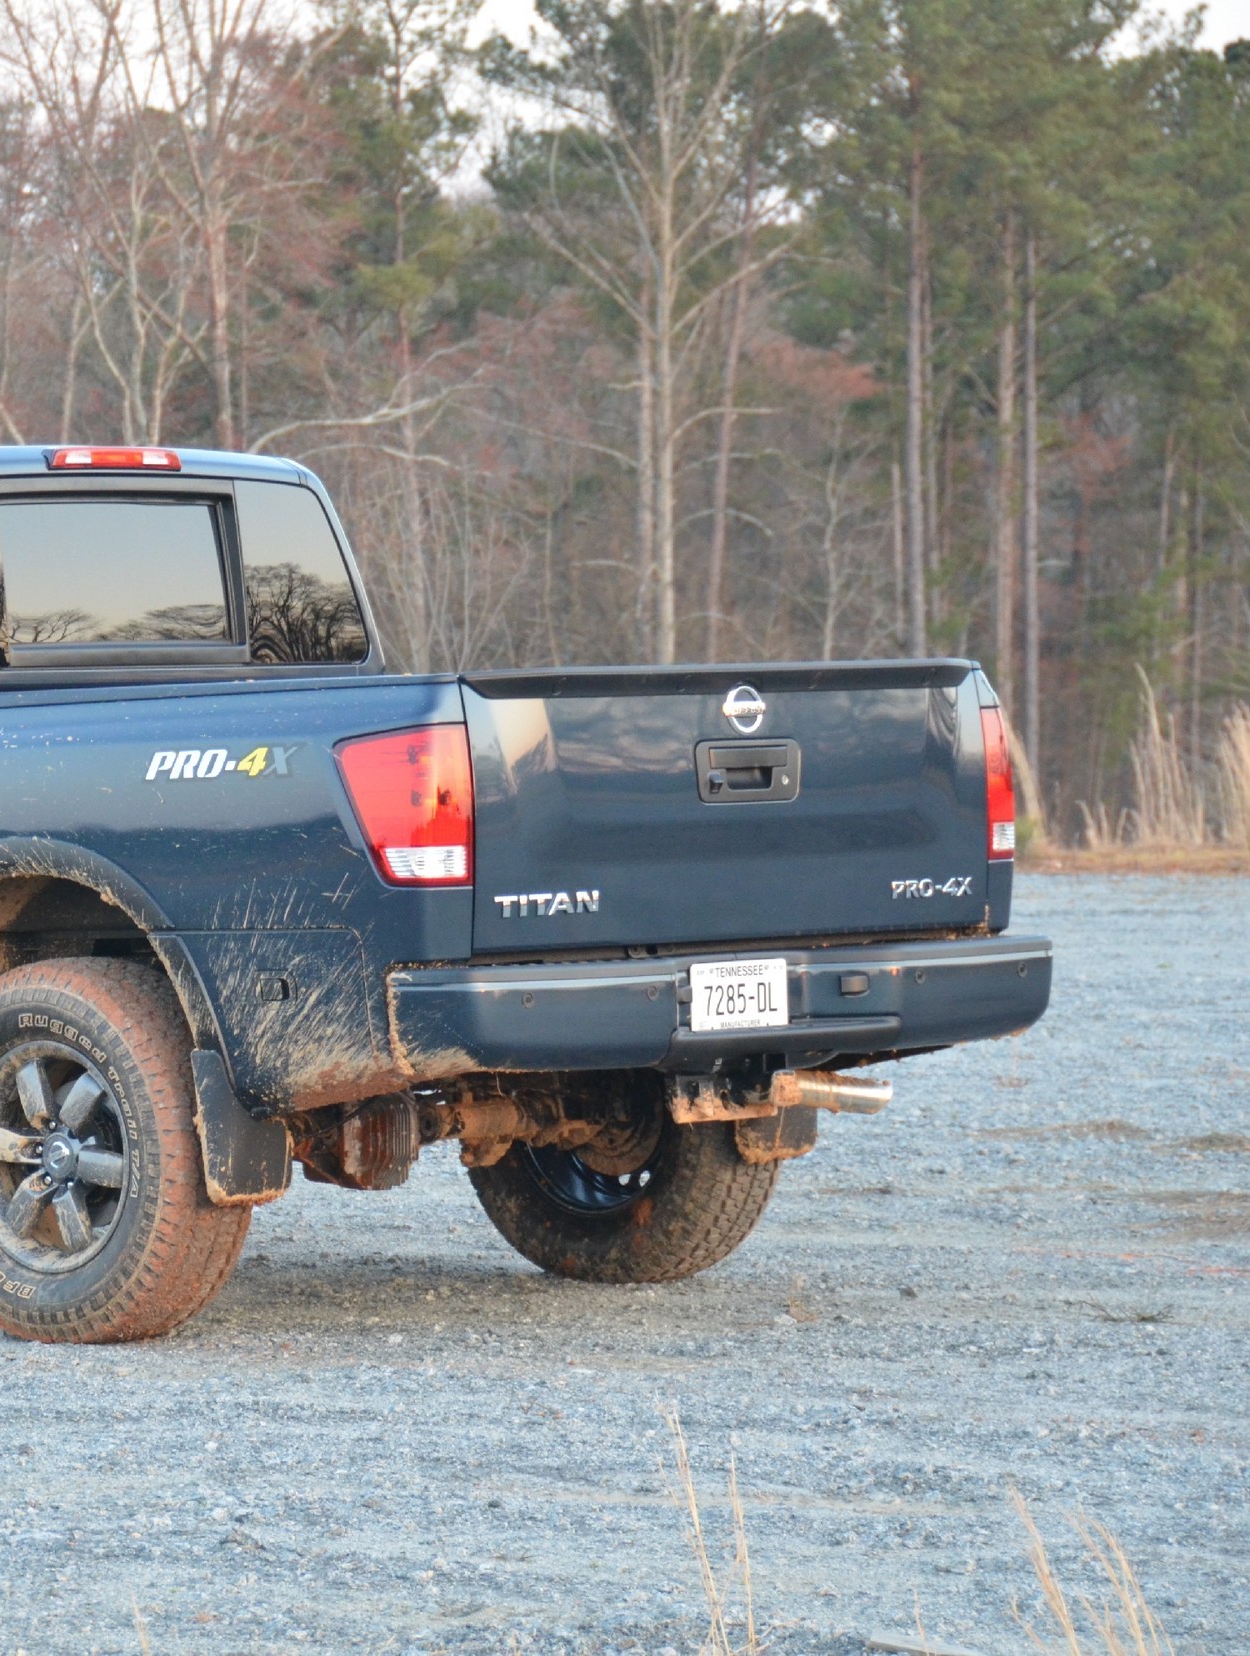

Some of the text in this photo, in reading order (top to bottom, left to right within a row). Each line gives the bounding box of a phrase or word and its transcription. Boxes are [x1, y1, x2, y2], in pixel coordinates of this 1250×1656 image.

[145, 746, 300, 781] PRO-4X
[891, 877, 972, 899] PRO-4X
[494, 890, 599, 918] TITAN
[715, 965, 763, 977] TENNESSEE
[704, 981, 778, 1016] 7285-DL
[18, 1013, 141, 1198] Rugged Trail T/A
